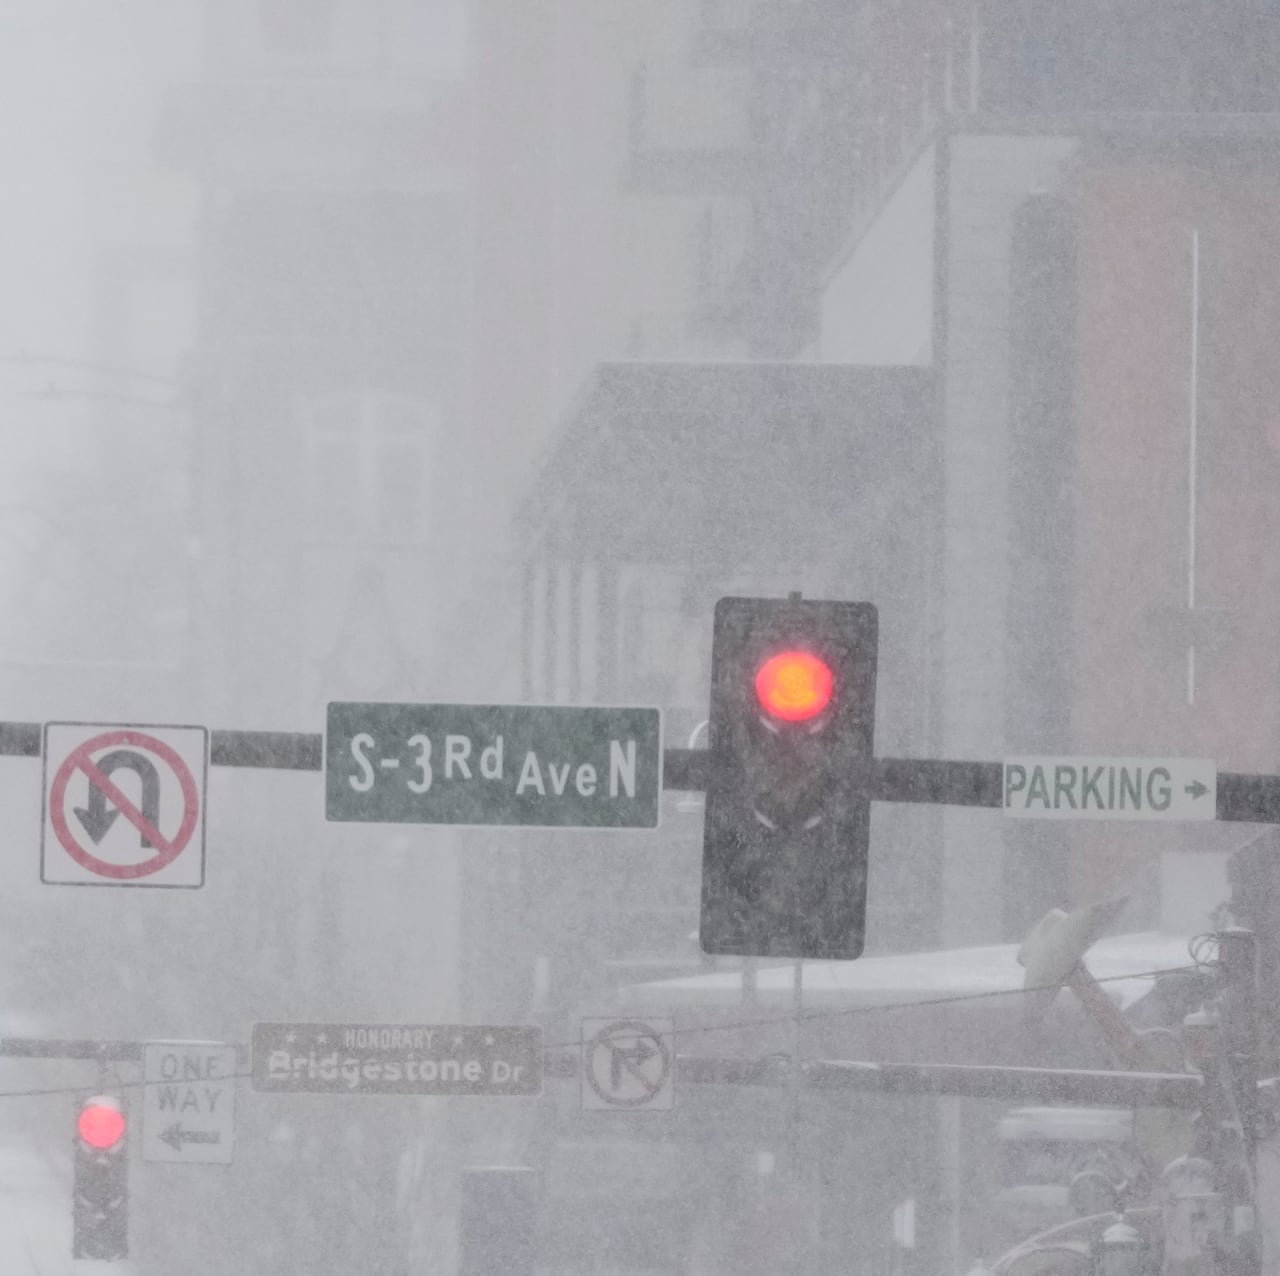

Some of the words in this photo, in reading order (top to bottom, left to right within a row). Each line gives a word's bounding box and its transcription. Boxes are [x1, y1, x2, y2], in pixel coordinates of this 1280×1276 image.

[516, 750, 597, 797] Ave
[609, 739, 637, 798] N
[1005, 764, 1173, 812] PARKING
[344, 1028, 435, 1050] HONORARY
[161, 1053, 221, 1081] ONE
[267, 1050, 483, 1088] Bridgestone
[491, 1060, 524, 1084] Dr
[157, 1086, 223, 1113] WAY
